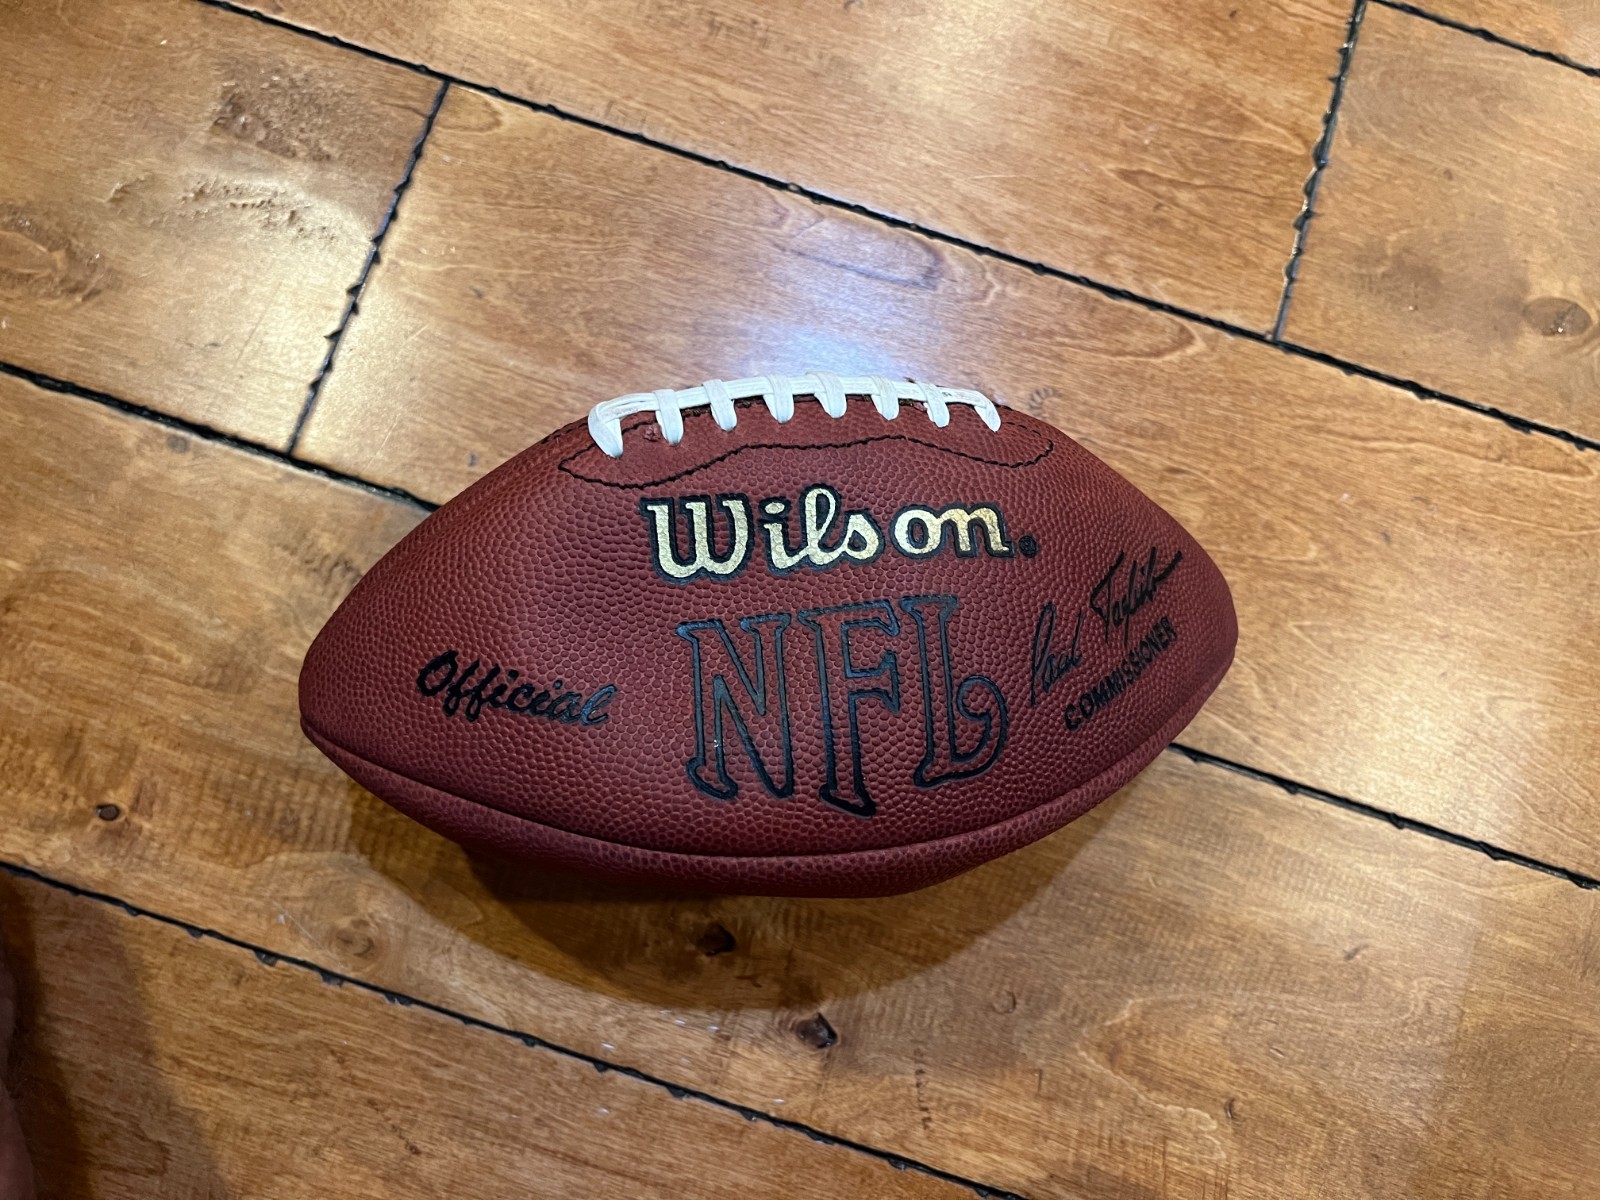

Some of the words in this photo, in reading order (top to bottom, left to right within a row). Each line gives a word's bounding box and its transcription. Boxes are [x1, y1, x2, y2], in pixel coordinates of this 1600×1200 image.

[640, 484, 1015, 584] Wilson
[416, 650, 617, 726] Official
[676, 595, 1009, 817] NFL
[1064, 615, 1178, 731] COMMISSIONER
